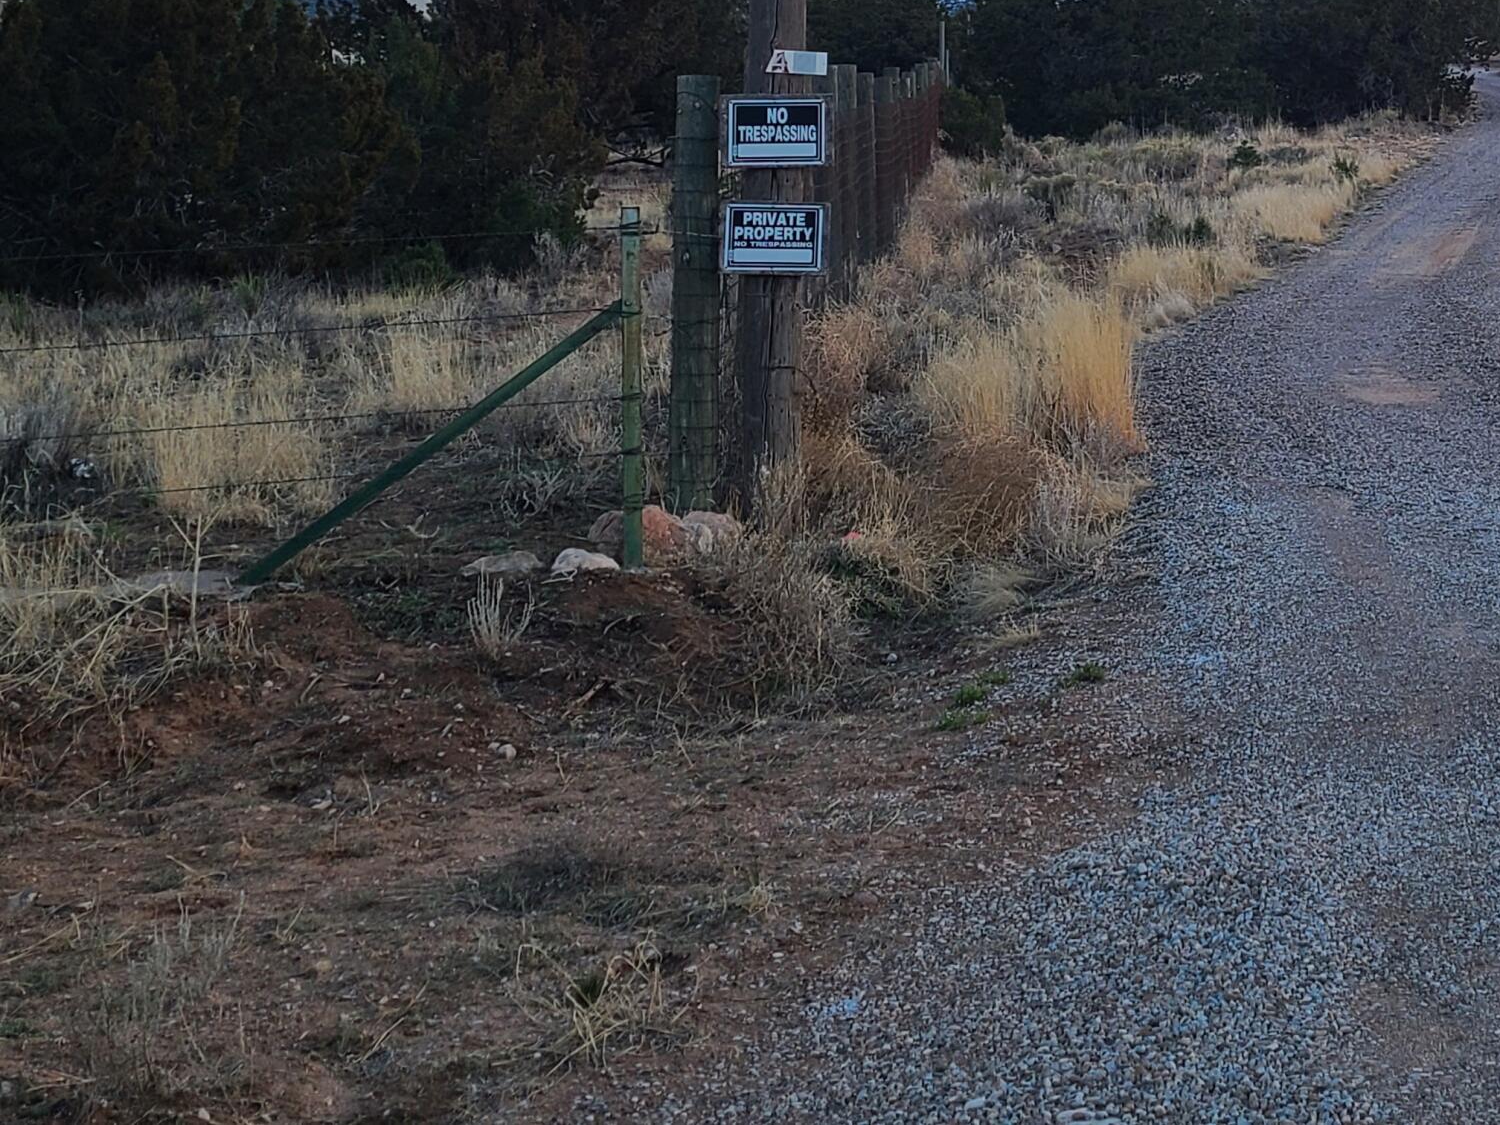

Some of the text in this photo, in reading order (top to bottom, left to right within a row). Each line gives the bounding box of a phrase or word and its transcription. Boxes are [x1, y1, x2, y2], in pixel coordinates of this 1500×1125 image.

[767, 107, 788, 124] NO
[738, 124, 817, 142] TRESPASSING
[743, 211, 806, 226] PRIVATE
[734, 226, 813, 241] PROPERTY
[750, 240, 813, 248] TRESPASSING
